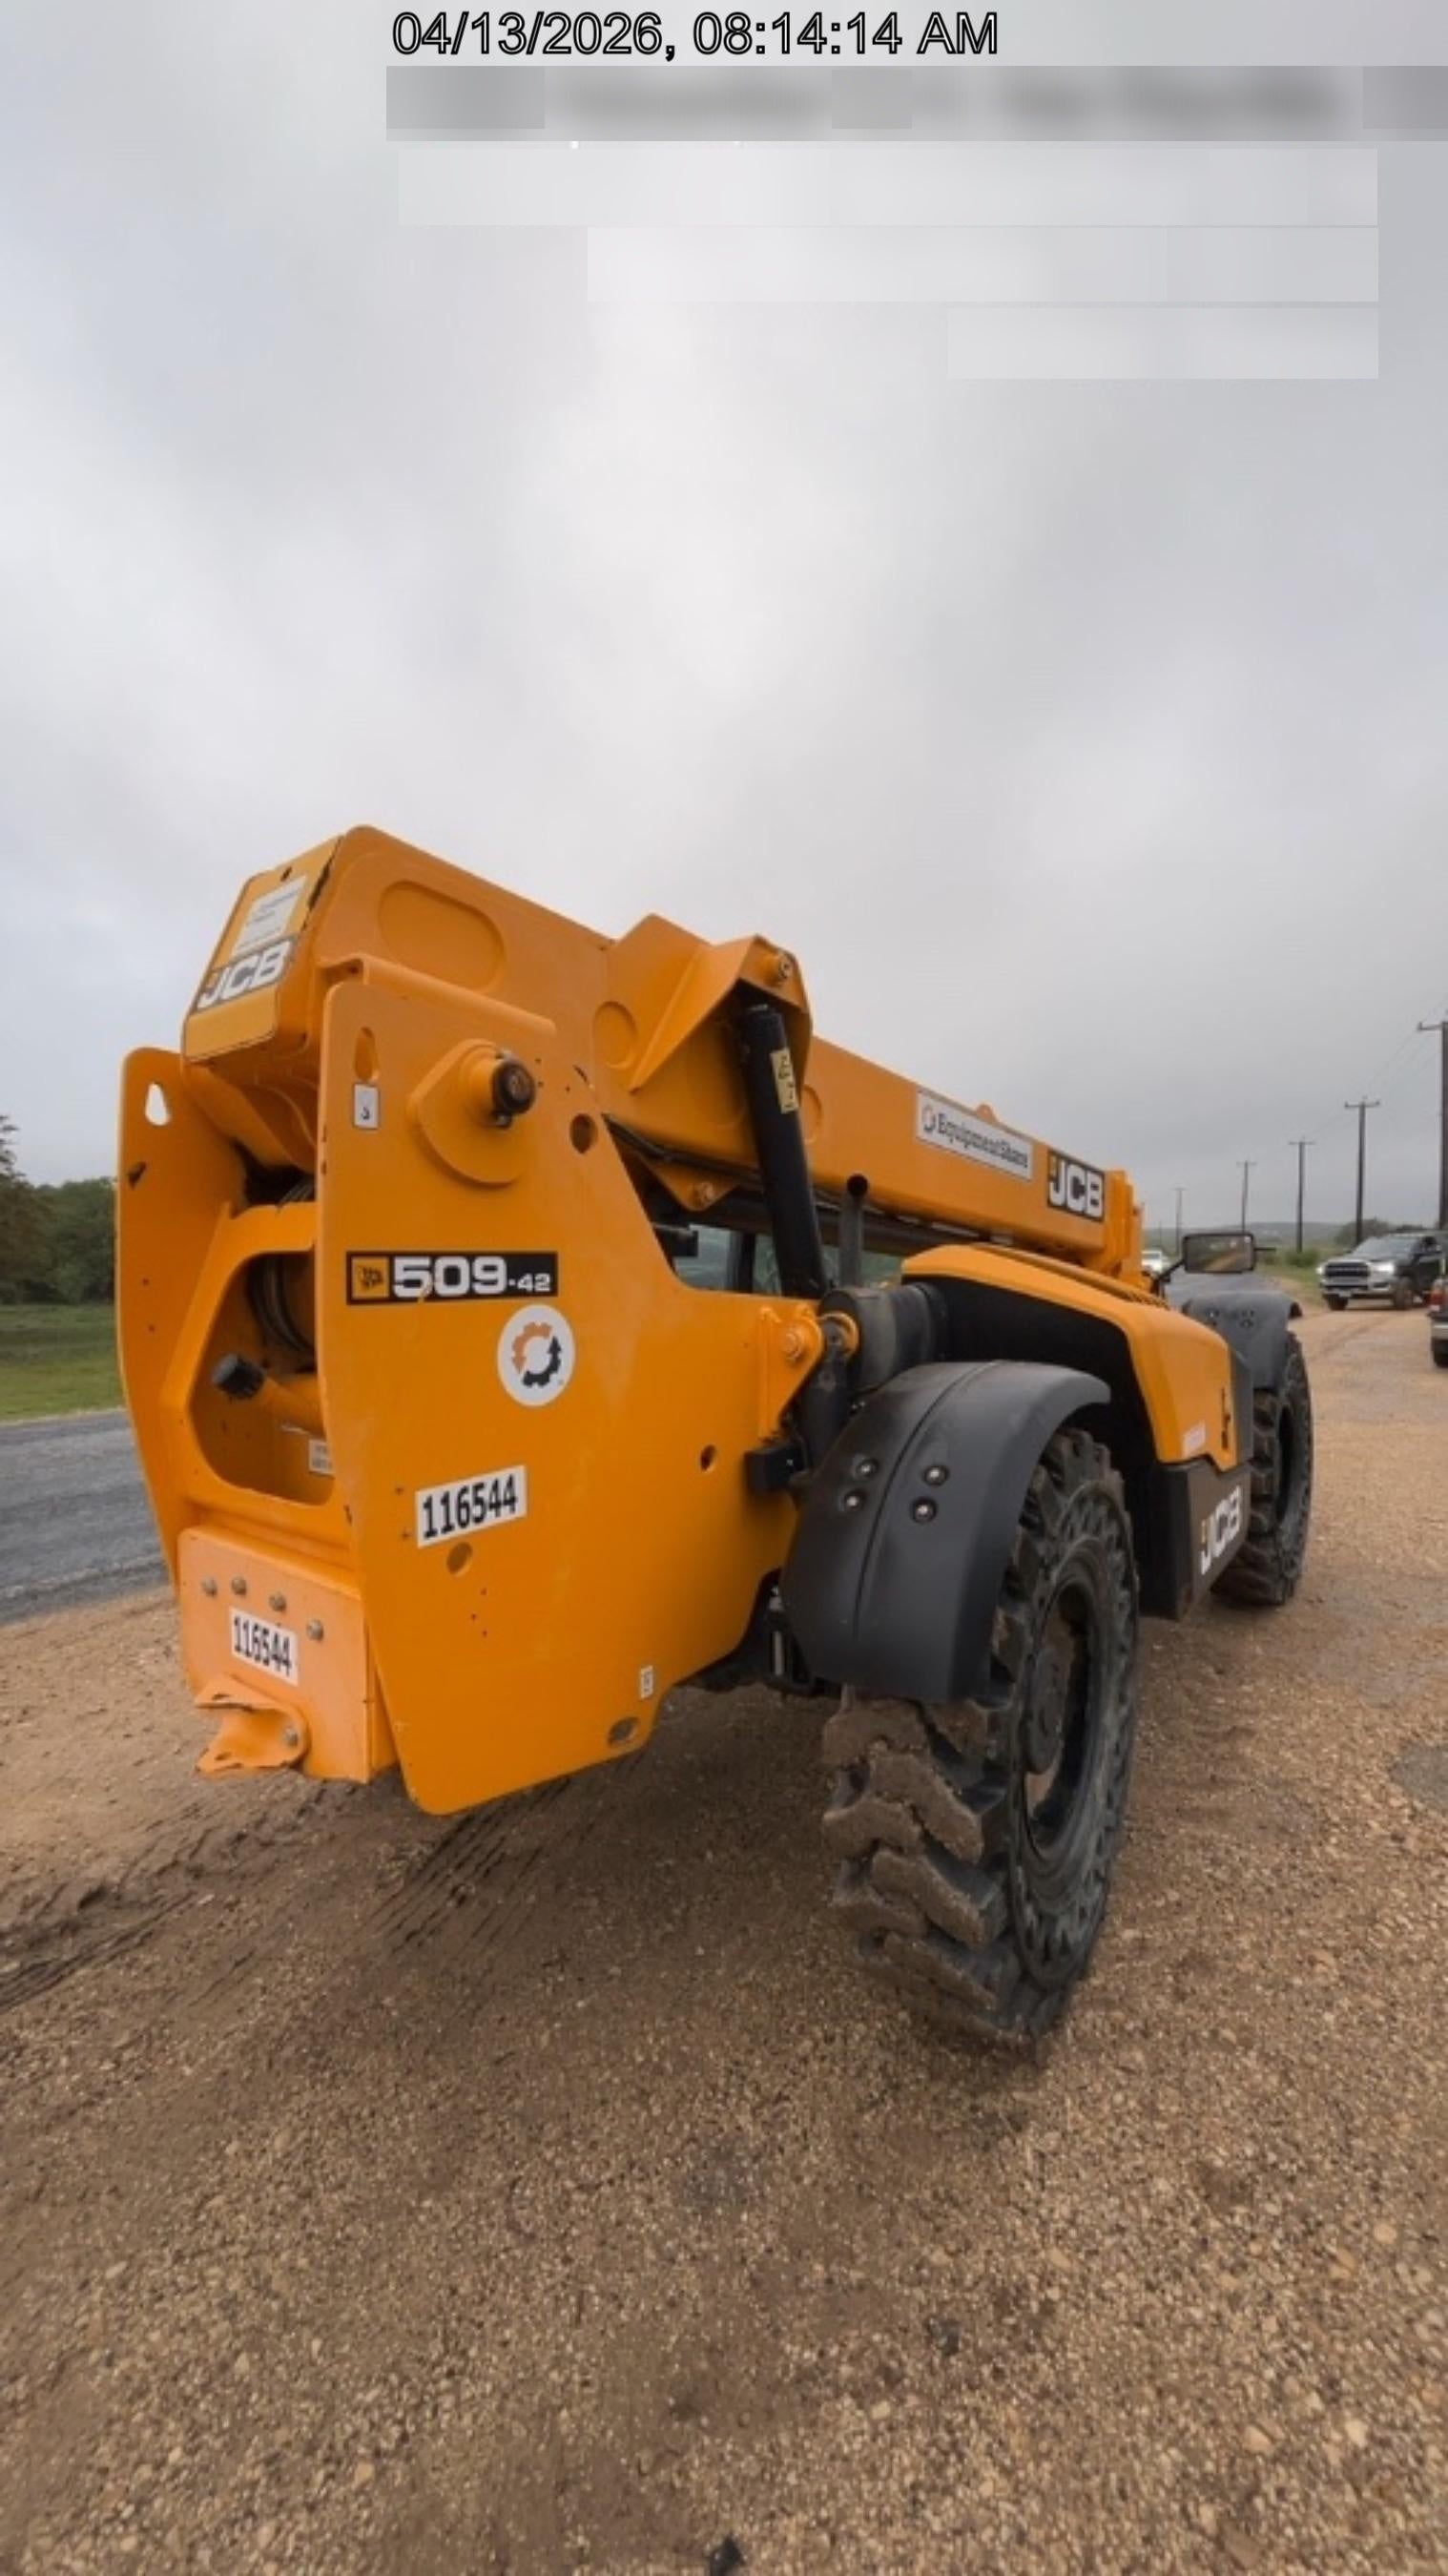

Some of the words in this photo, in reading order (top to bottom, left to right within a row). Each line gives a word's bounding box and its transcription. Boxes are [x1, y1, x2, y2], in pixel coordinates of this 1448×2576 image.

[197, 940, 293, 1009] JCB
[1048, 1154, 1104, 1218] JCB
[392, 1255, 552, 1298] 509-42
[423, 1474, 517, 1540] 116544
[1200, 1485, 1242, 1576] JCB
[234, 1616, 292, 1676] 116544
